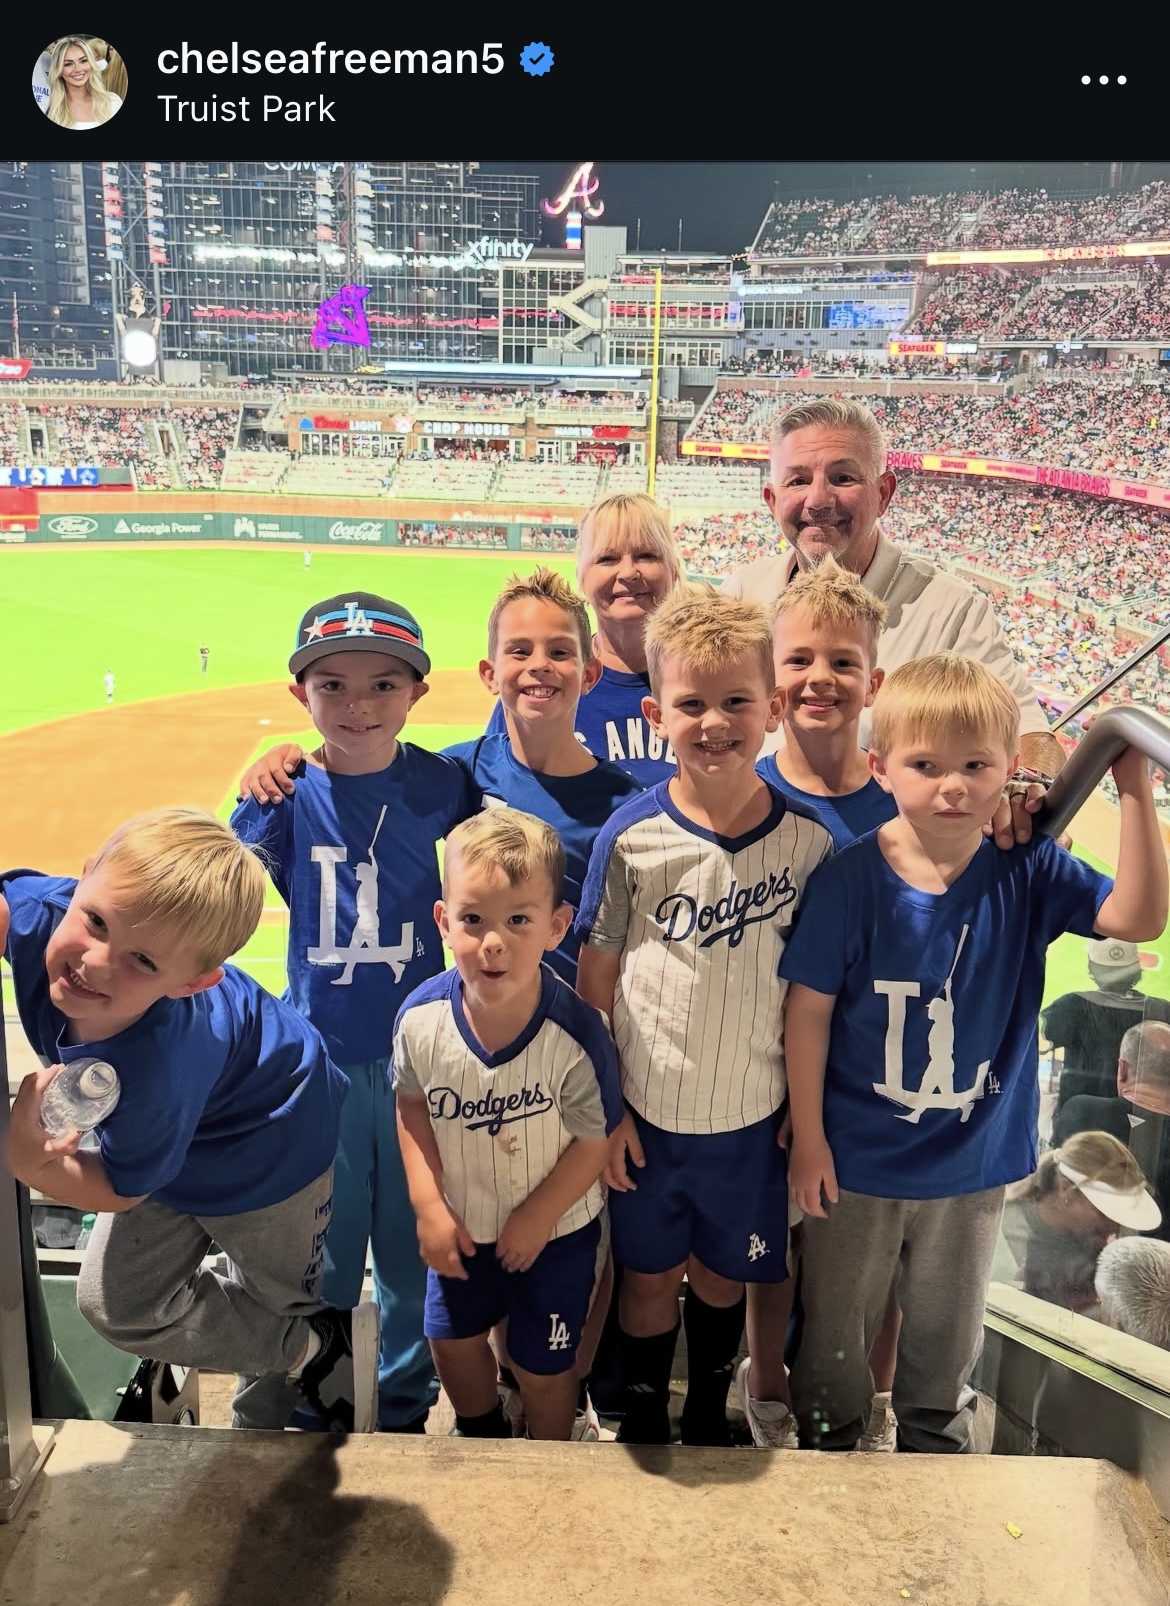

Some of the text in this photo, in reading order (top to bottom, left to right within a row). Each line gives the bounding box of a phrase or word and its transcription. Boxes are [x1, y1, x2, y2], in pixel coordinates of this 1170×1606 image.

[468, 236, 534, 263] xfinity
[898, 344, 936, 353] SEATGEEK
[349, 421, 382, 431] LIGHT
[423, 422, 510, 436] CHOP HOUSE
[886, 452, 923, 469] BRAVES
[131, 522, 202, 535] Georgia Power
[344, 602, 375, 635] LA
[655, 867, 797, 948] Dodgers
[988, 1071, 1002, 1094] LA
[428, 1082, 553, 1136] Dodgers
[748, 1233, 766, 1262] LA
[549, 1313, 570, 1350] LA
